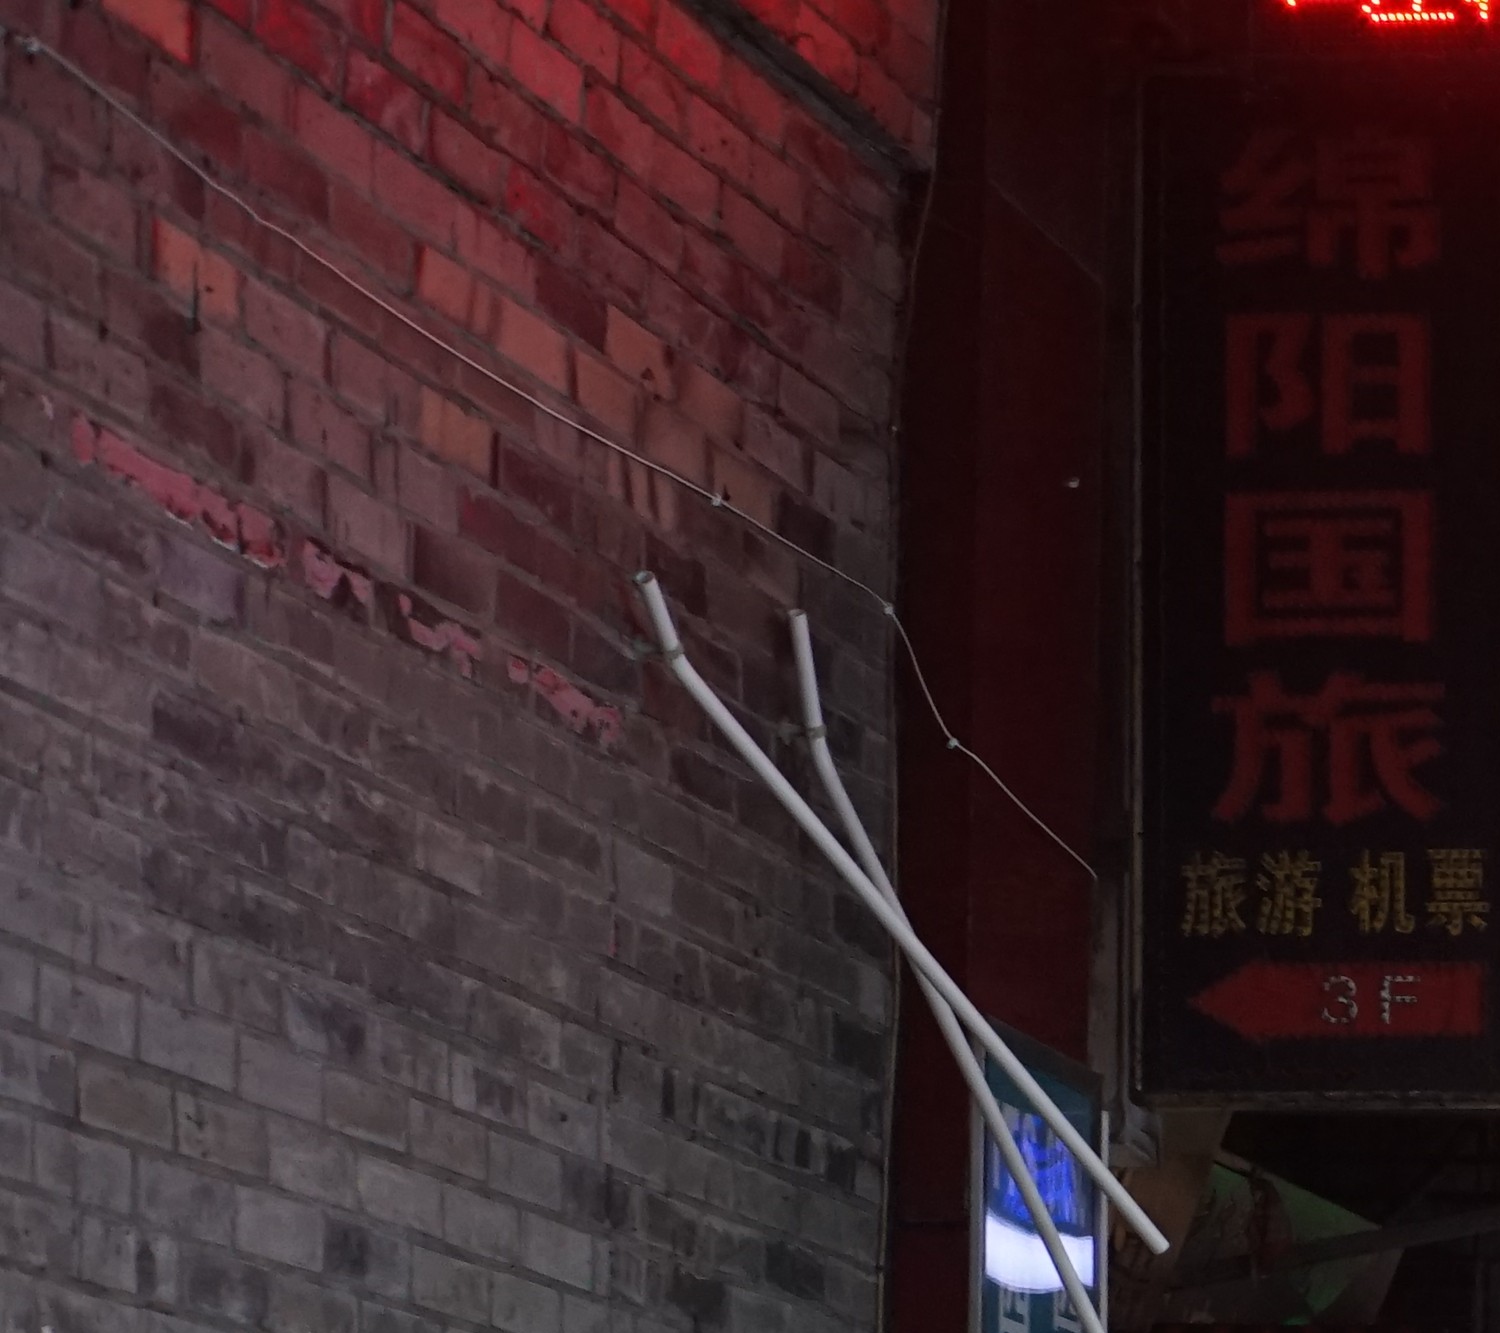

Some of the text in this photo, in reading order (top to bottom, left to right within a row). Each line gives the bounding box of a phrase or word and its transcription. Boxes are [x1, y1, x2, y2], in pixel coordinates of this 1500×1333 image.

[1181, 849, 1491, 937] 旅游 机票
[1321, 974, 1421, 1025] 3F
